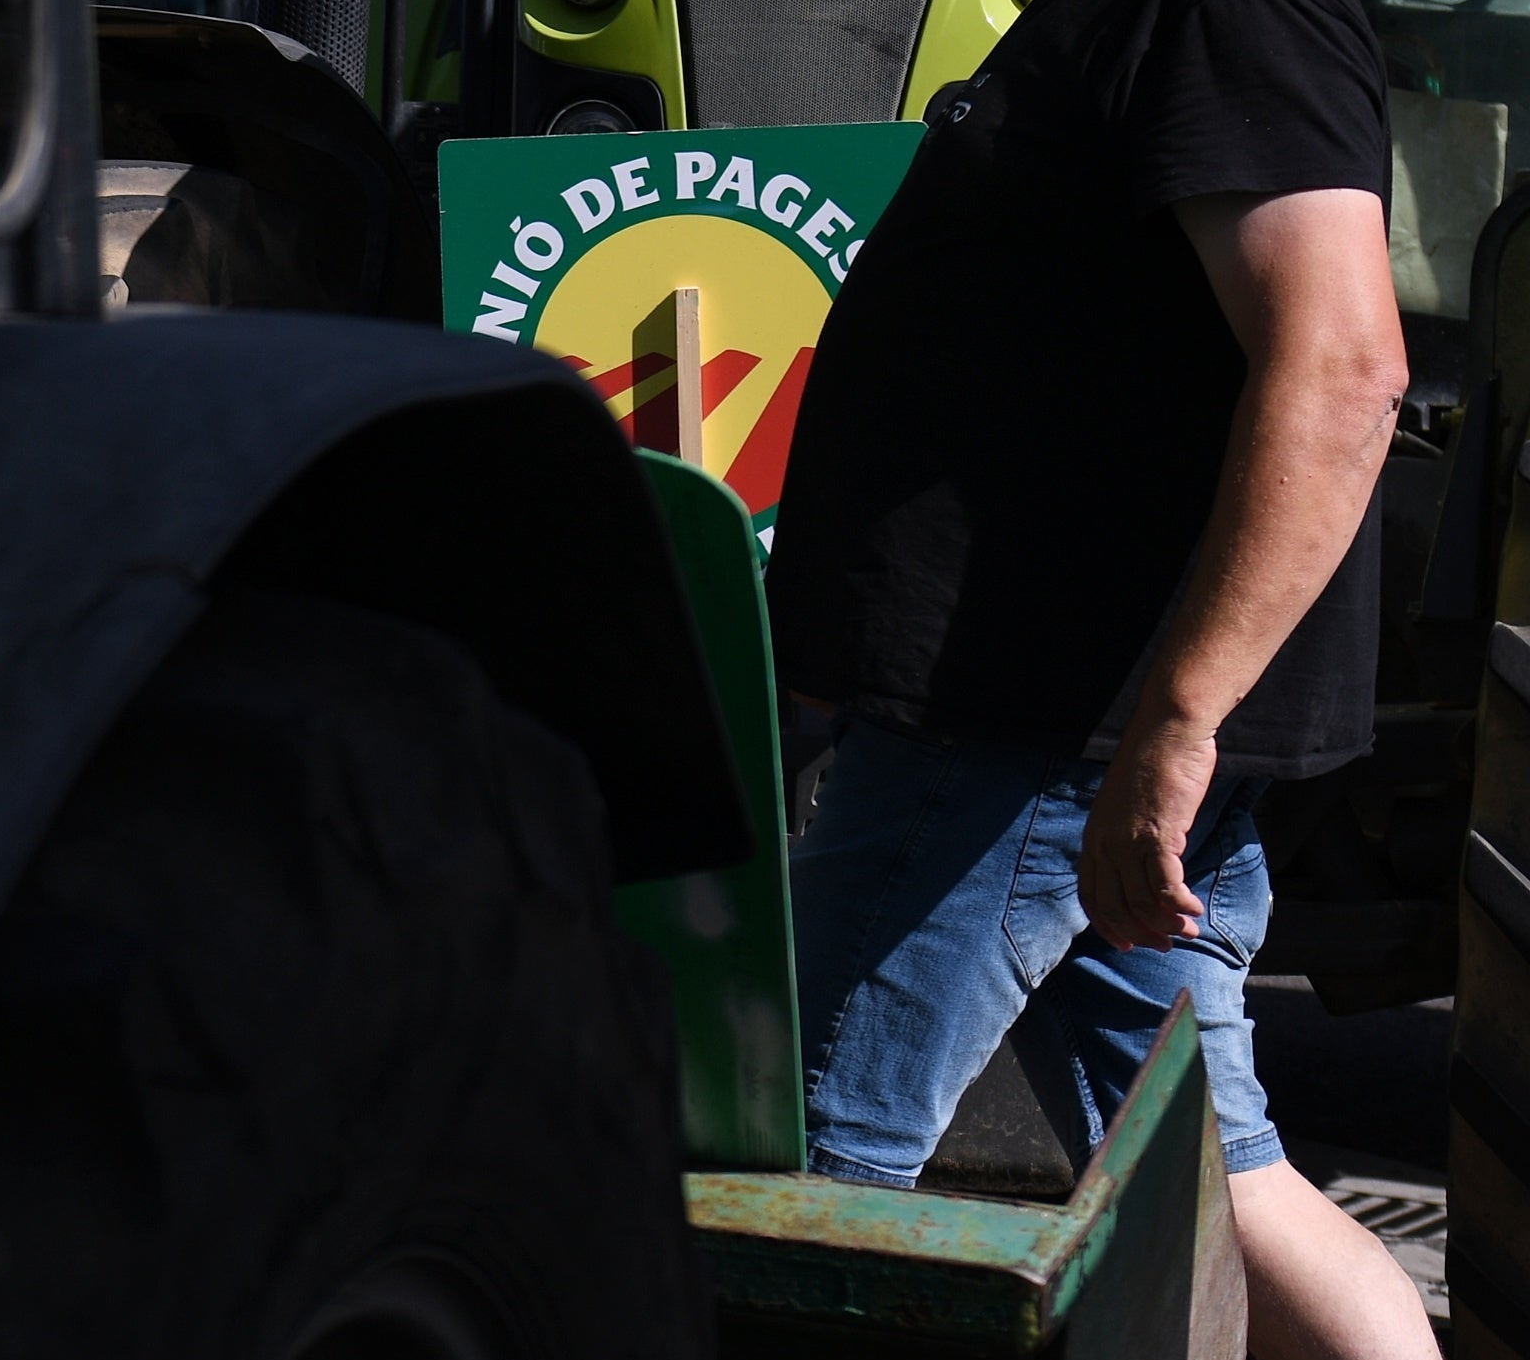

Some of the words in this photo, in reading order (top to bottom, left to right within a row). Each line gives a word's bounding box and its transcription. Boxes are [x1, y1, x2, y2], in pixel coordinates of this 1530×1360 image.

[470, 214, 565, 345] NIÓ
[559, 155, 660, 235] DE
[672, 150, 867, 284] PAGES
